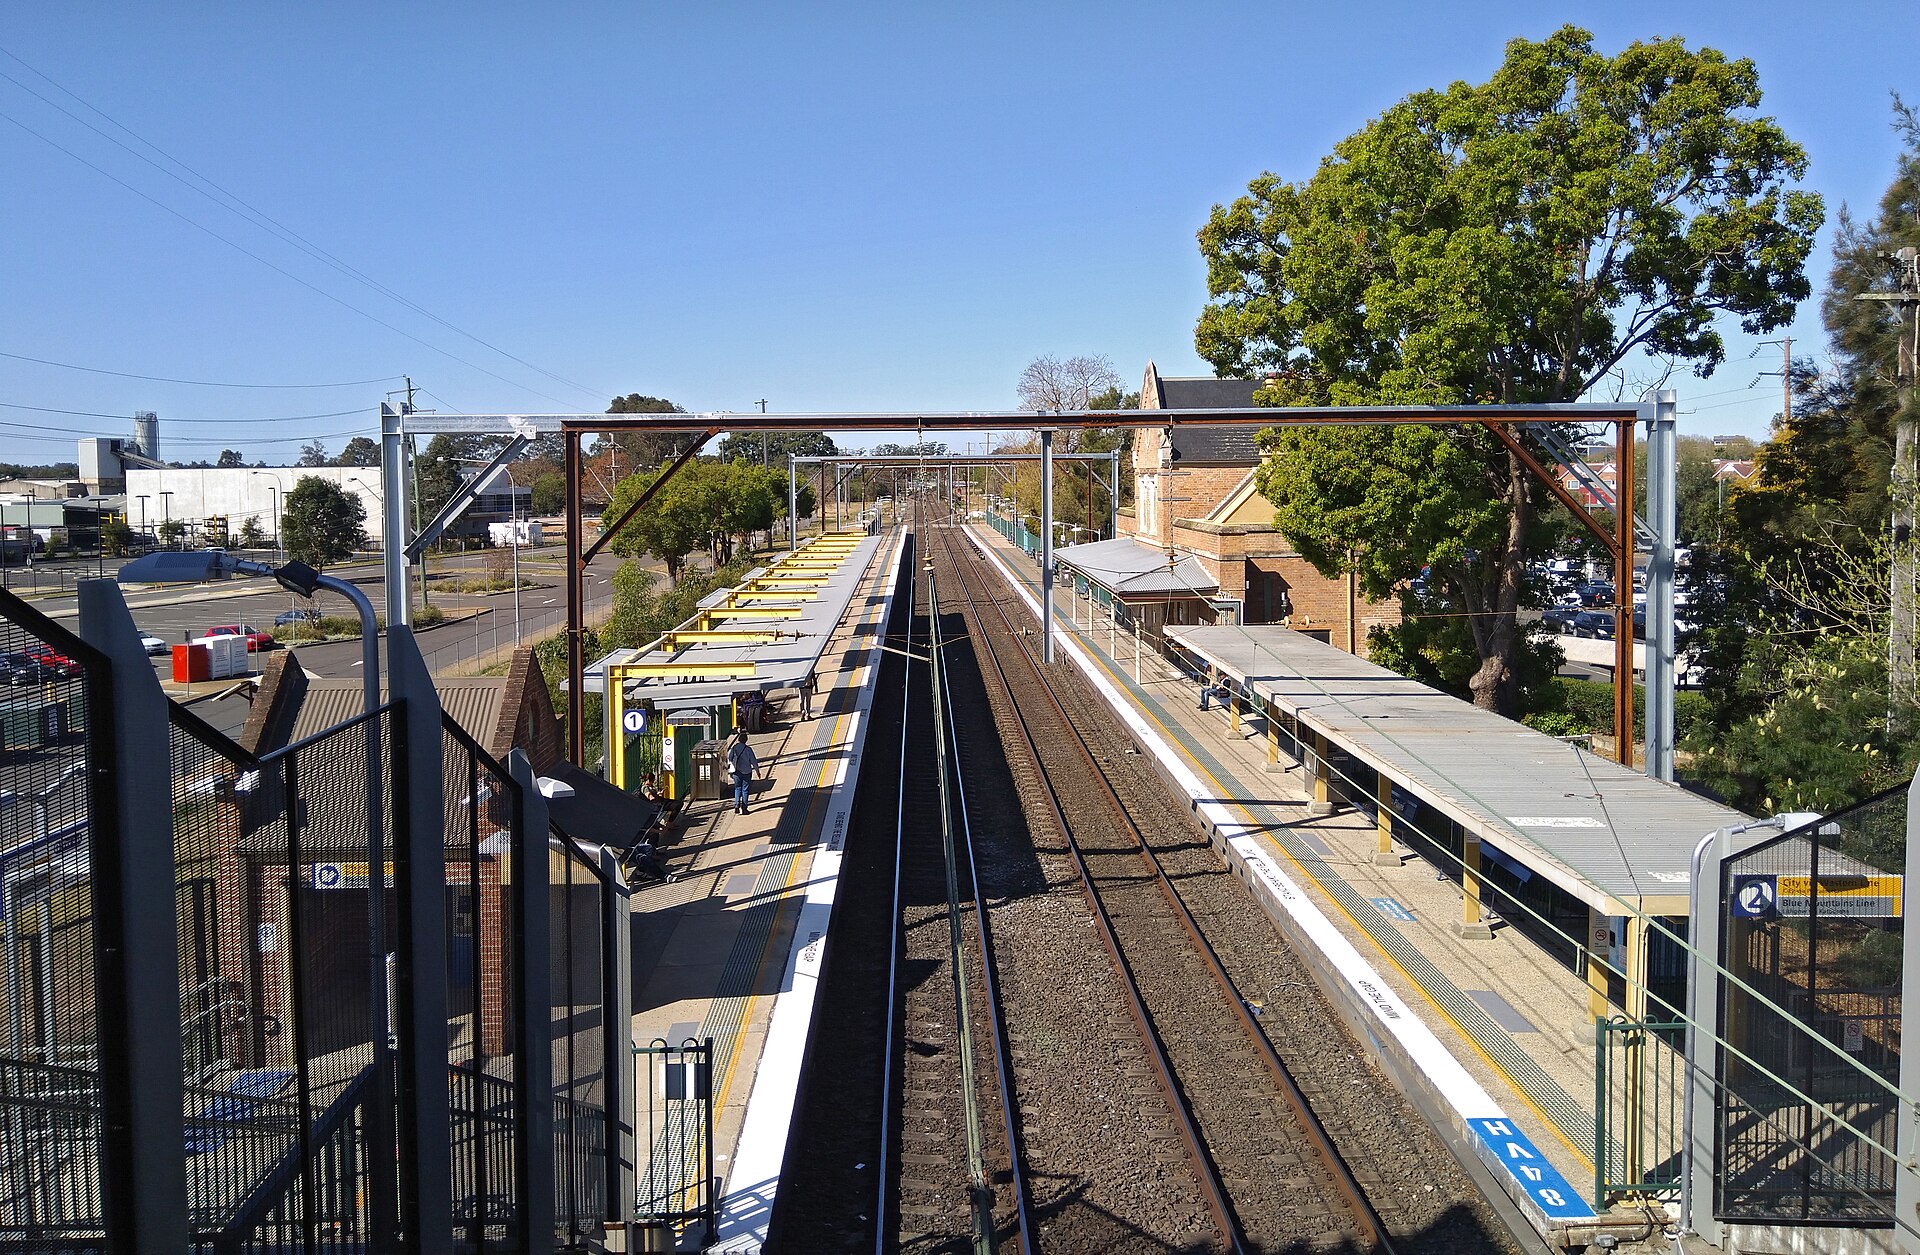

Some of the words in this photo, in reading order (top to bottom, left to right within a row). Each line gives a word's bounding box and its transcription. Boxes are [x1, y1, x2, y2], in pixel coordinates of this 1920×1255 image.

[629, 714, 637, 728] 1
[1783, 878, 1800, 888] City
[1747, 883, 1764, 909] 2
[1782, 899, 1803, 907] Blue
[1856, 899, 1875, 907] Line
[803, 952, 816, 962] GAP
[1359, 980, 1377, 993] GAP
[1368, 993, 1387, 1004] THE
[1379, 1005, 1401, 1019] MIND
[1482, 1121, 1512, 1135] H
[1519, 1165, 1541, 1181] 4
[1538, 1188, 1566, 1206] 8
